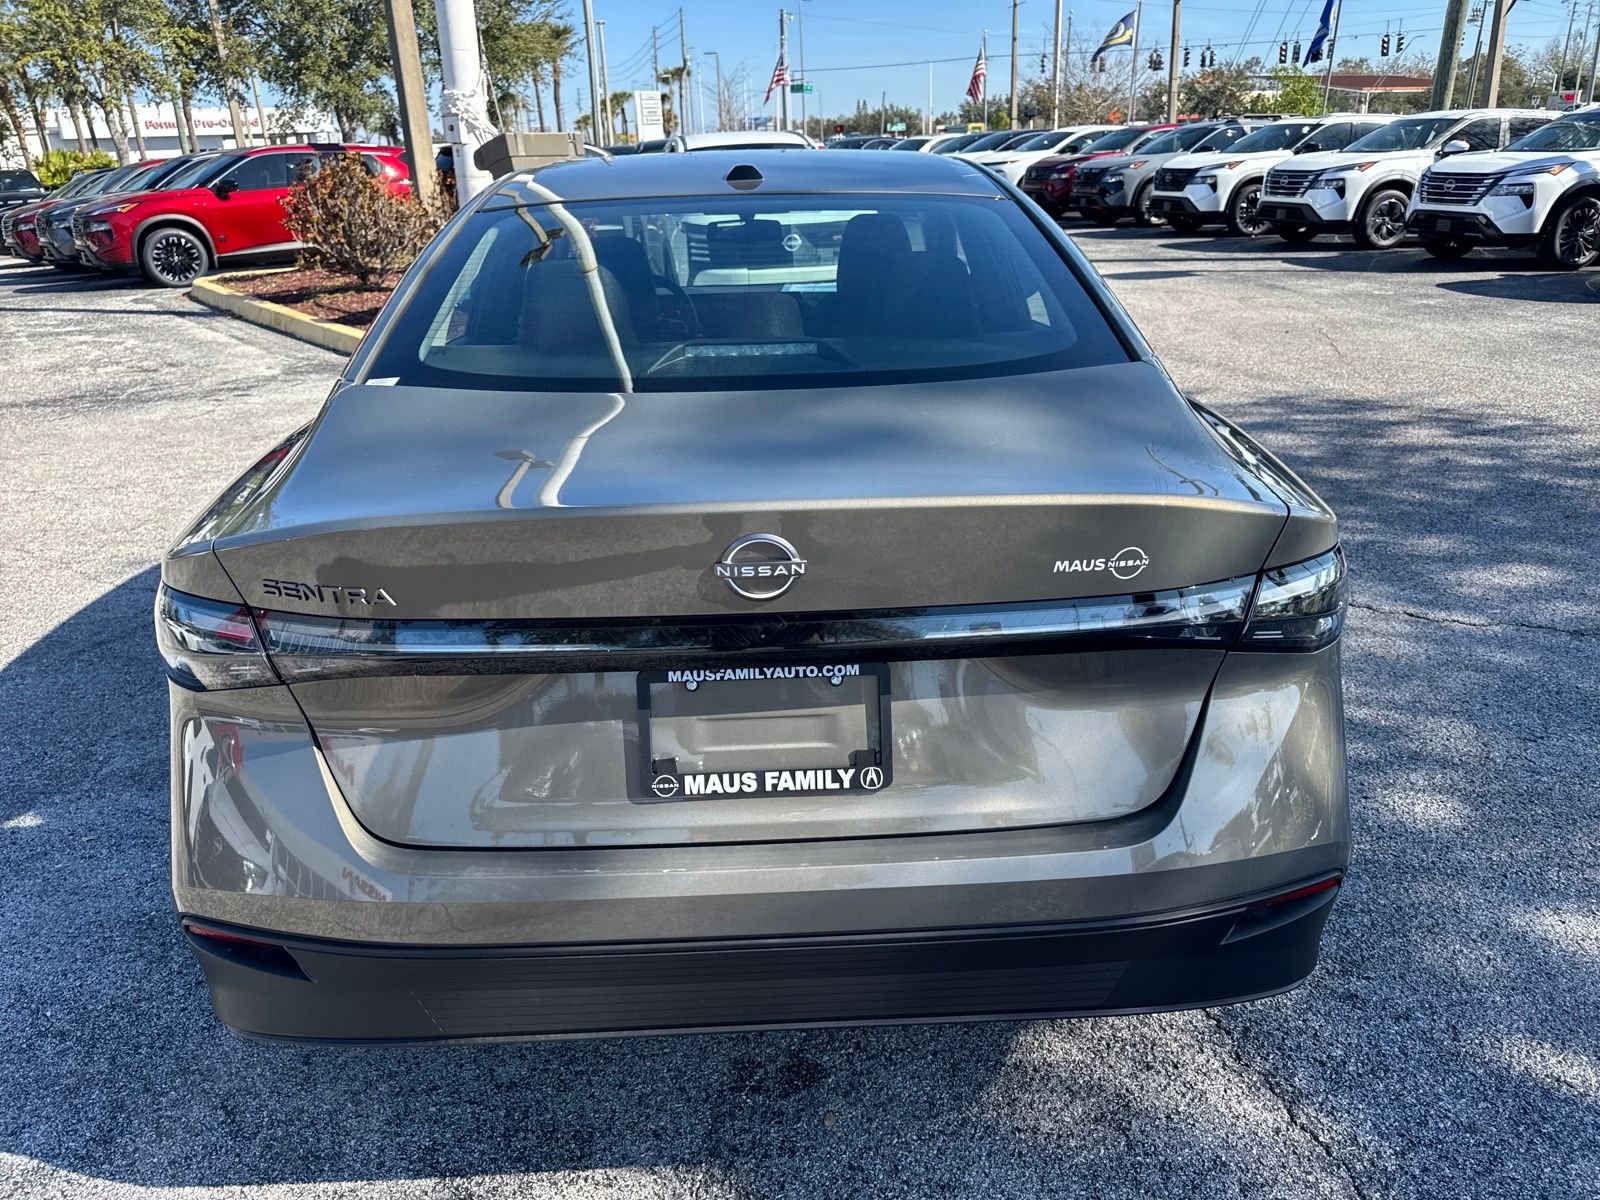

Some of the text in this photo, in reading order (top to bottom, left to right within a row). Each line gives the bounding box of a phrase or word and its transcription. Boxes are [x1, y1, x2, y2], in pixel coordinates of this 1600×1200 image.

[716, 563, 805, 577] NISSAN
[1053, 559, 1149, 572] MAUS NISSAN
[262, 578, 397, 606] SENTRA
[668, 664, 860, 683] MAUSFAMILYAUTO.COM
[651, 782, 680, 790] NISSAN
[684, 768, 856, 795] MAUS FAMILY
